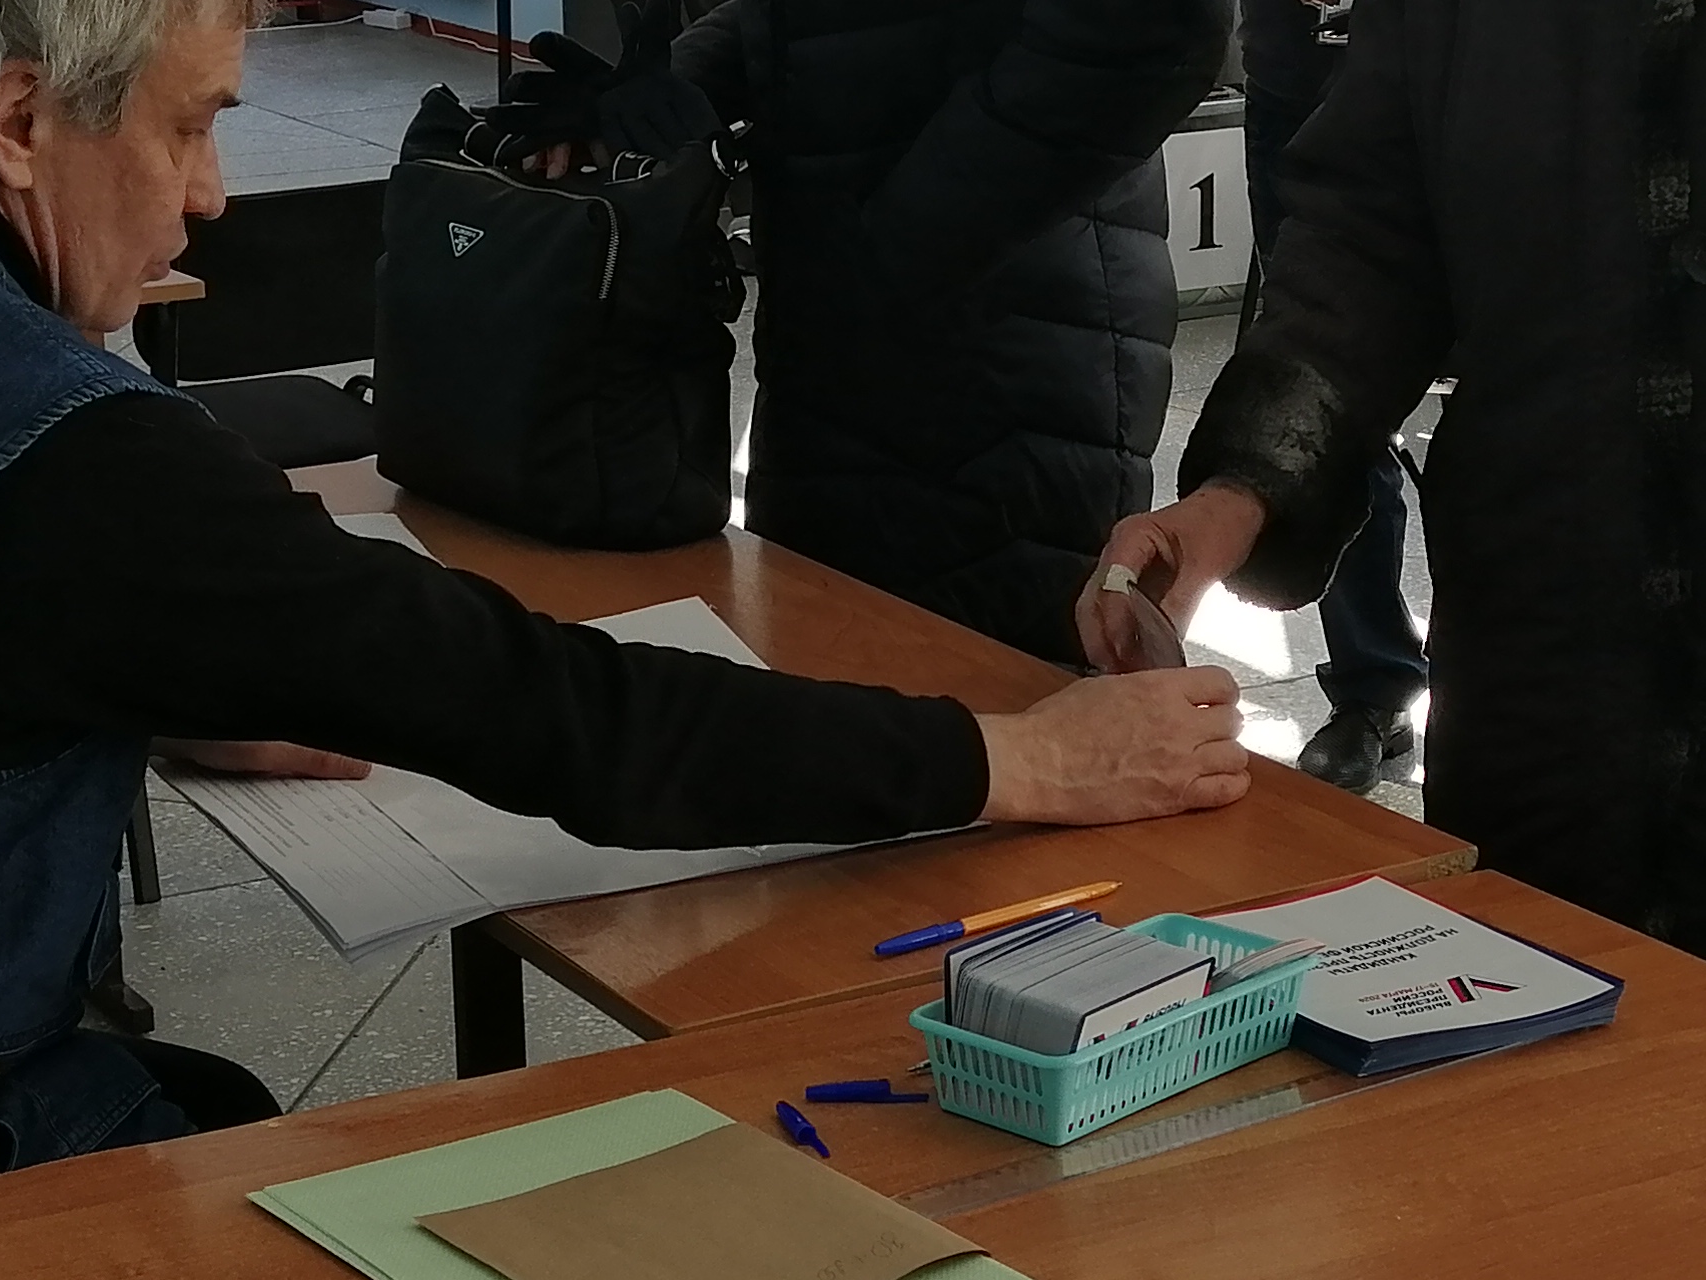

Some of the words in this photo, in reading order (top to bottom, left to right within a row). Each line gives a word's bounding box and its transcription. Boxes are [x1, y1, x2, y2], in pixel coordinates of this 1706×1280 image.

[1188, 172, 1223, 252] 1
[1341, 924, 1436, 956] РОССИЙСКОЙ
[1435, 927, 1459, 939] НА
[1348, 933, 1437, 962] ДОЛЖНОСТЬ
[1327, 952, 1418, 976] КАНДИДАТЫ
[1358, 993, 1381, 1003] 2024
[1382, 987, 1413, 999] МАРТА
[1392, 988, 1445, 1004] РОССИИ
[1366, 994, 1449, 1017] ПРЕЗИДЕНТА
[1395, 1000, 1452, 1018] ВЫБОРЫ
